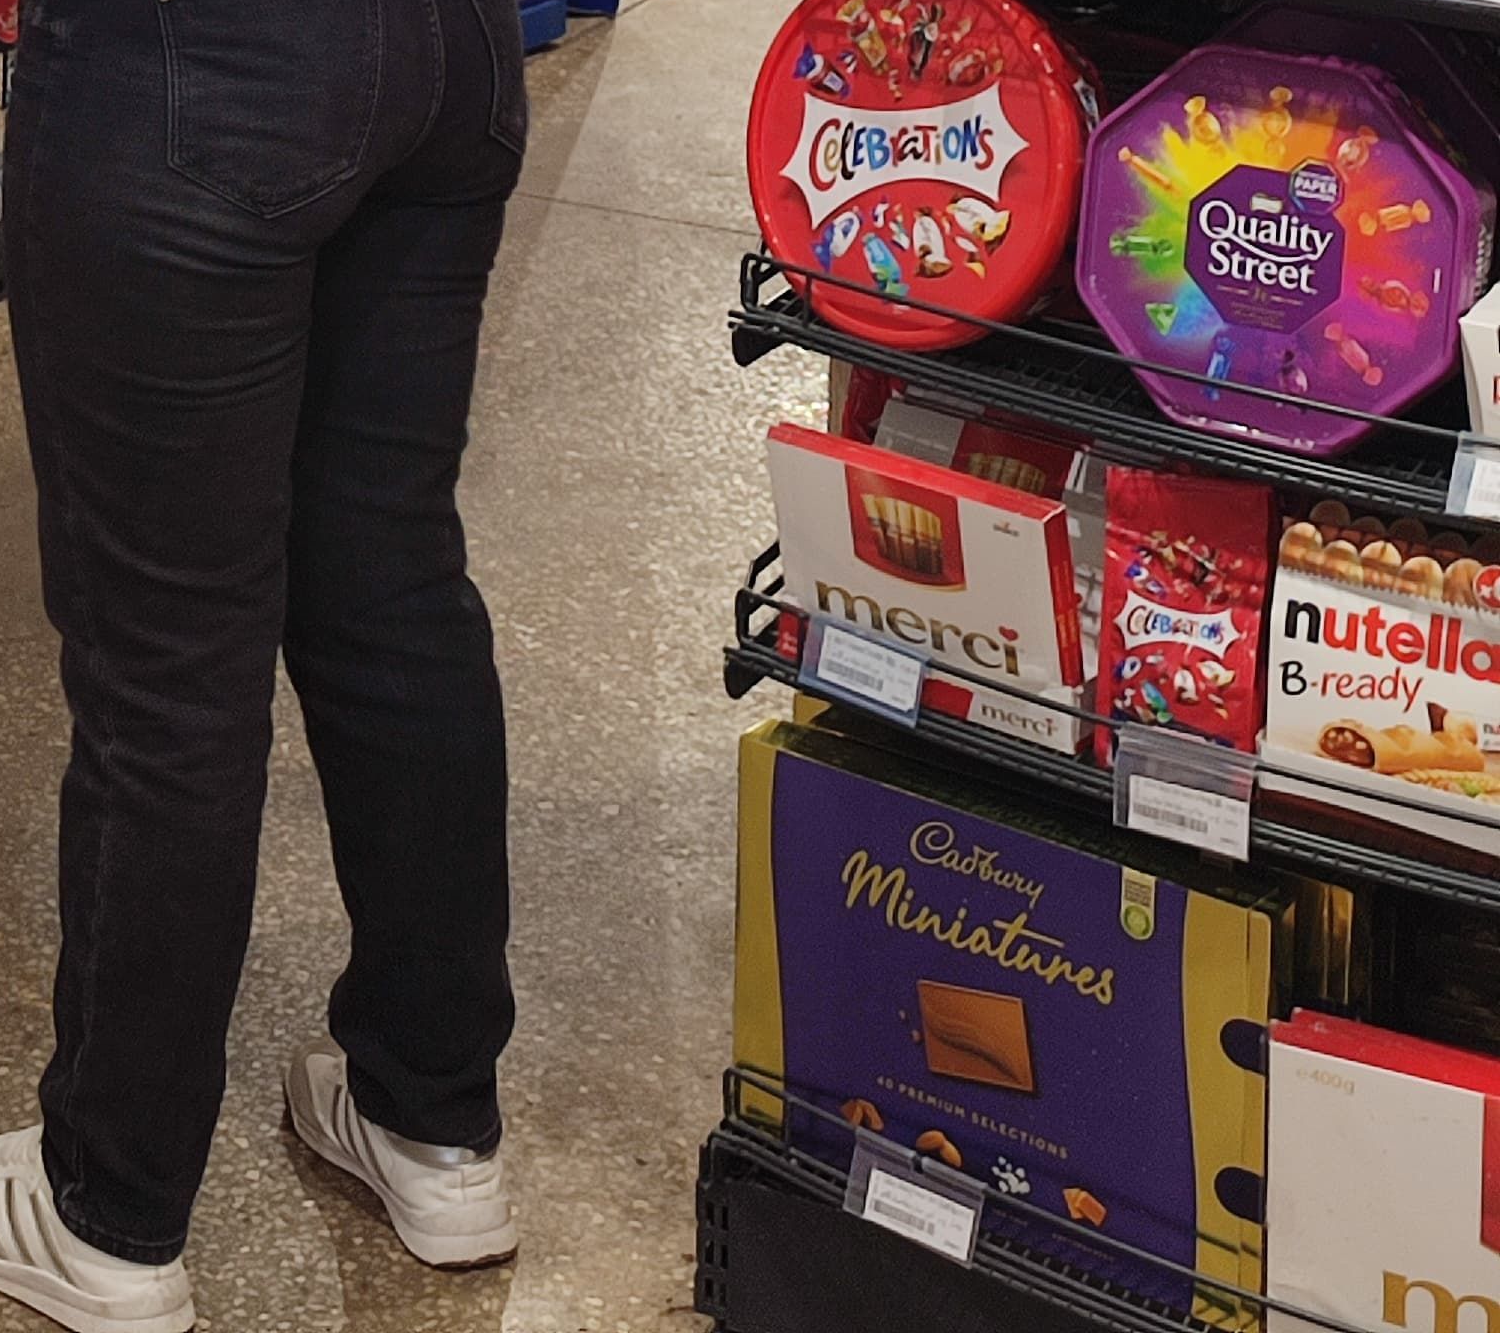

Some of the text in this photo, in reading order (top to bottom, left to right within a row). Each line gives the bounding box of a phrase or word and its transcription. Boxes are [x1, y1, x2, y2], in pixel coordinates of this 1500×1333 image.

[1295, 177, 1337, 196] PAPER
[1198, 199, 1334, 263] Quality
[1208, 240, 1318, 295] Street
[814, 579, 1021, 677] merci
[1284, 598, 1500, 685] nutella
[980, 701, 1057, 736] merci
[1280, 660, 1423, 713] B-ready
[910, 820, 1045, 906] Cadbury
[840, 850, 1115, 1004] Miniatures
[899, 1084, 966, 1119] PREMIUM
[971, 1112, 1069, 1160] SELECTIONS
